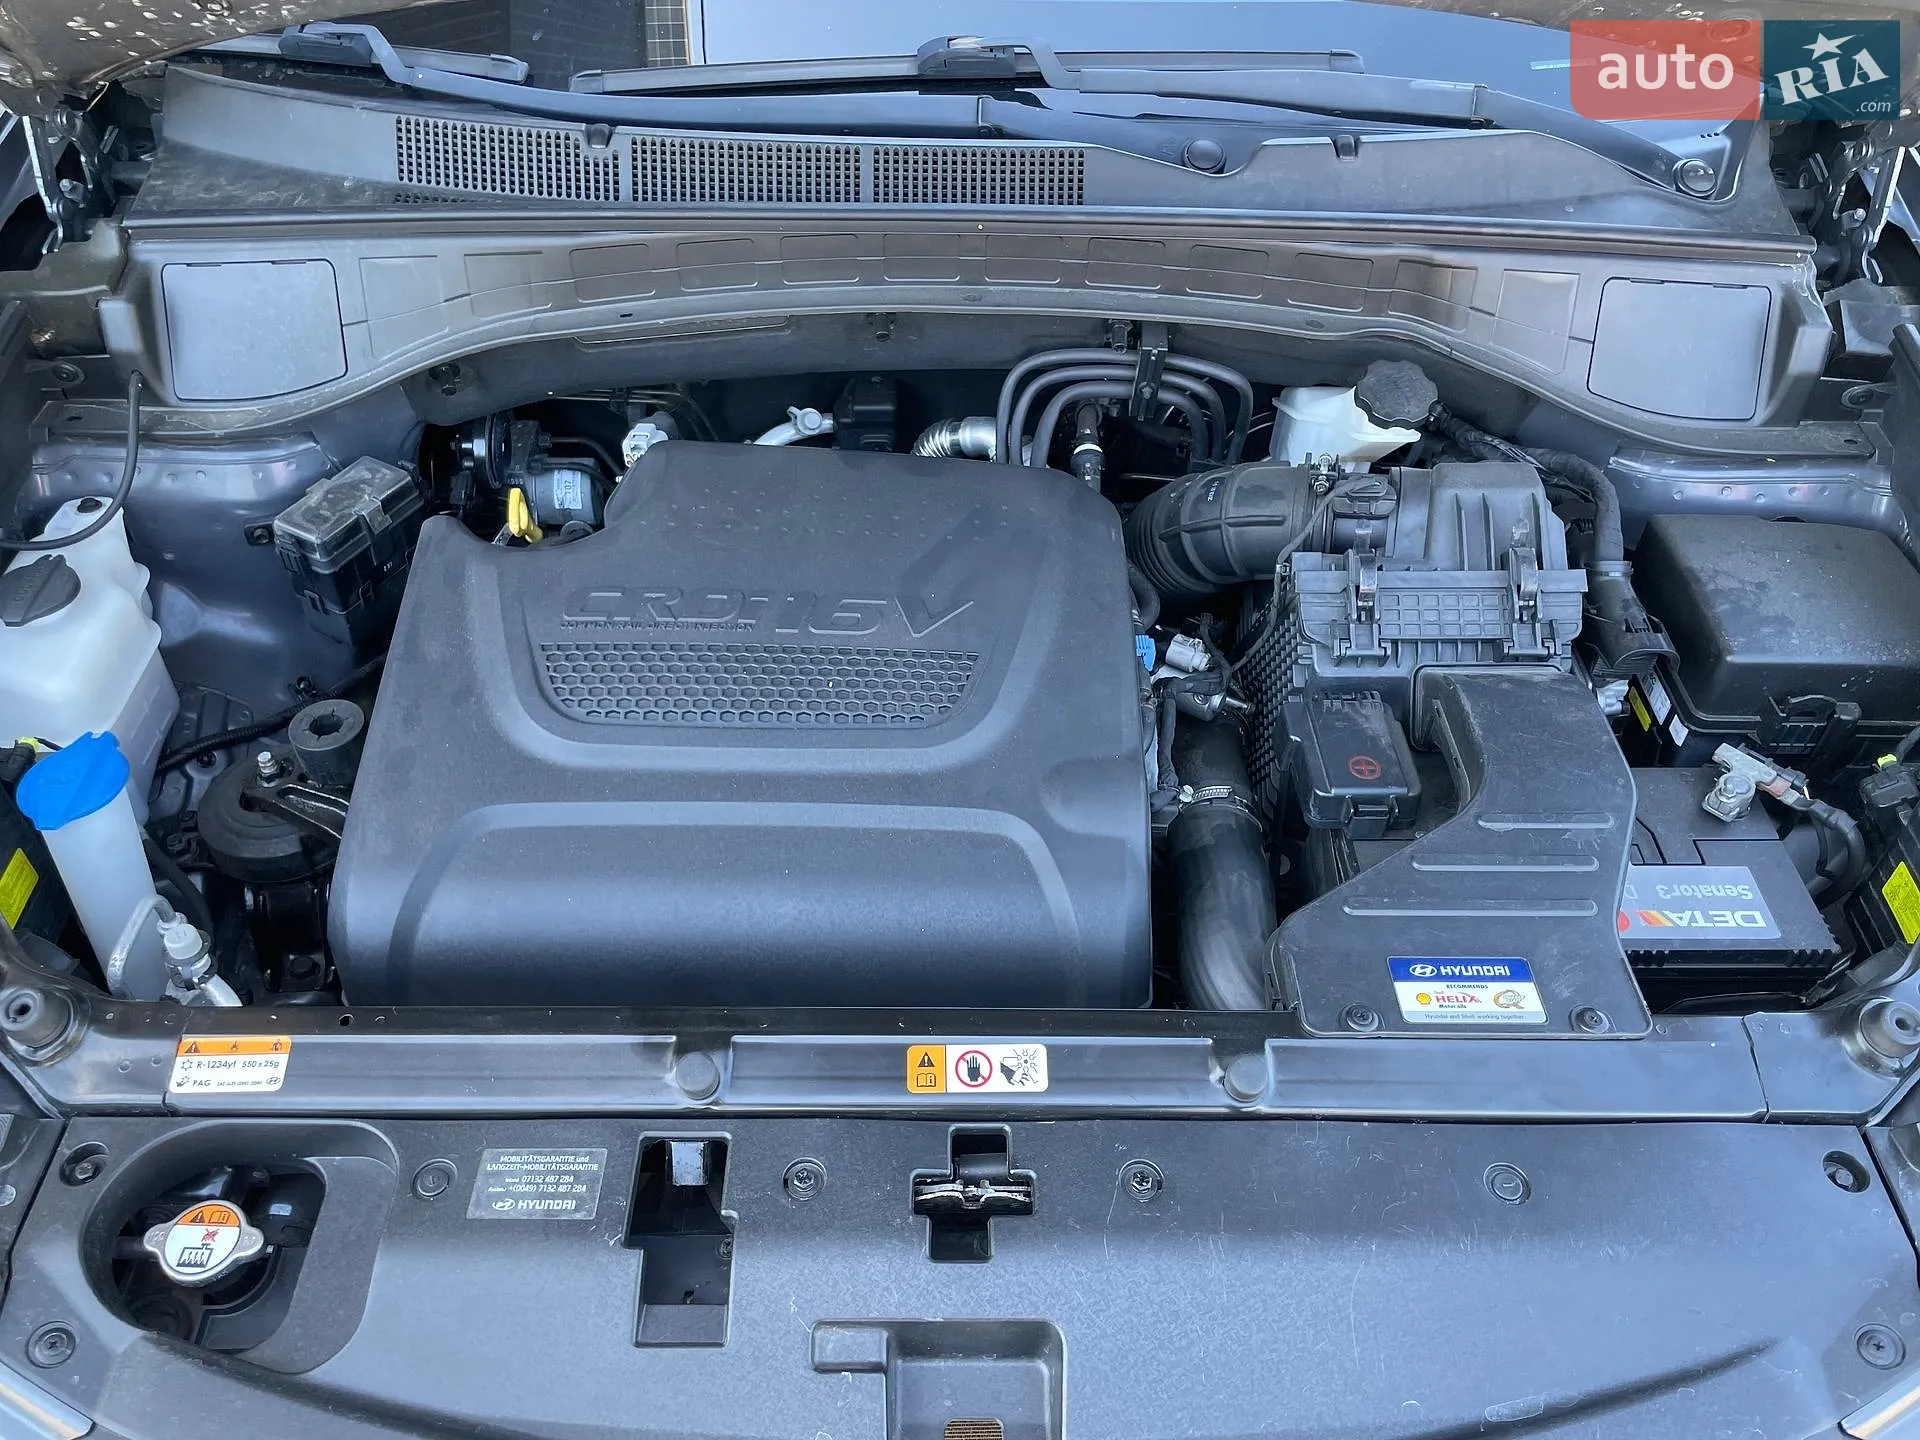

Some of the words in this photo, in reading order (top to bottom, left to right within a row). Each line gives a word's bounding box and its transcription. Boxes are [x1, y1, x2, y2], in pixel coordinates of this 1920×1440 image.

[560, 621, 613, 632] COMMON
[613, 621, 643, 632] RAIL
[1661, 910, 1767, 928] DETA
[1441, 966, 1511, 976] HYUNDAI
[1435, 994, 1480, 1004] HELIX
[192, 1079, 212, 1087] PAG
[500, 1154, 575, 1163] MOBILITÄTSGARANTIE
[576, 1155, 590, 1163] und
[486, 1163, 599, 1171] LANGZEIT-MOBILITÄTSGARANTIE
[521, 1175, 544, 1183] 07132
[544, 1175, 559, 1183] 487
[559, 1175, 575, 1183] 284
[538, 1184, 557, 1193] 7132
[557, 1184, 572, 1192] 487
[572, 1184, 587, 1192] 284
[518, 1200, 576, 1210] HYUNDAI
